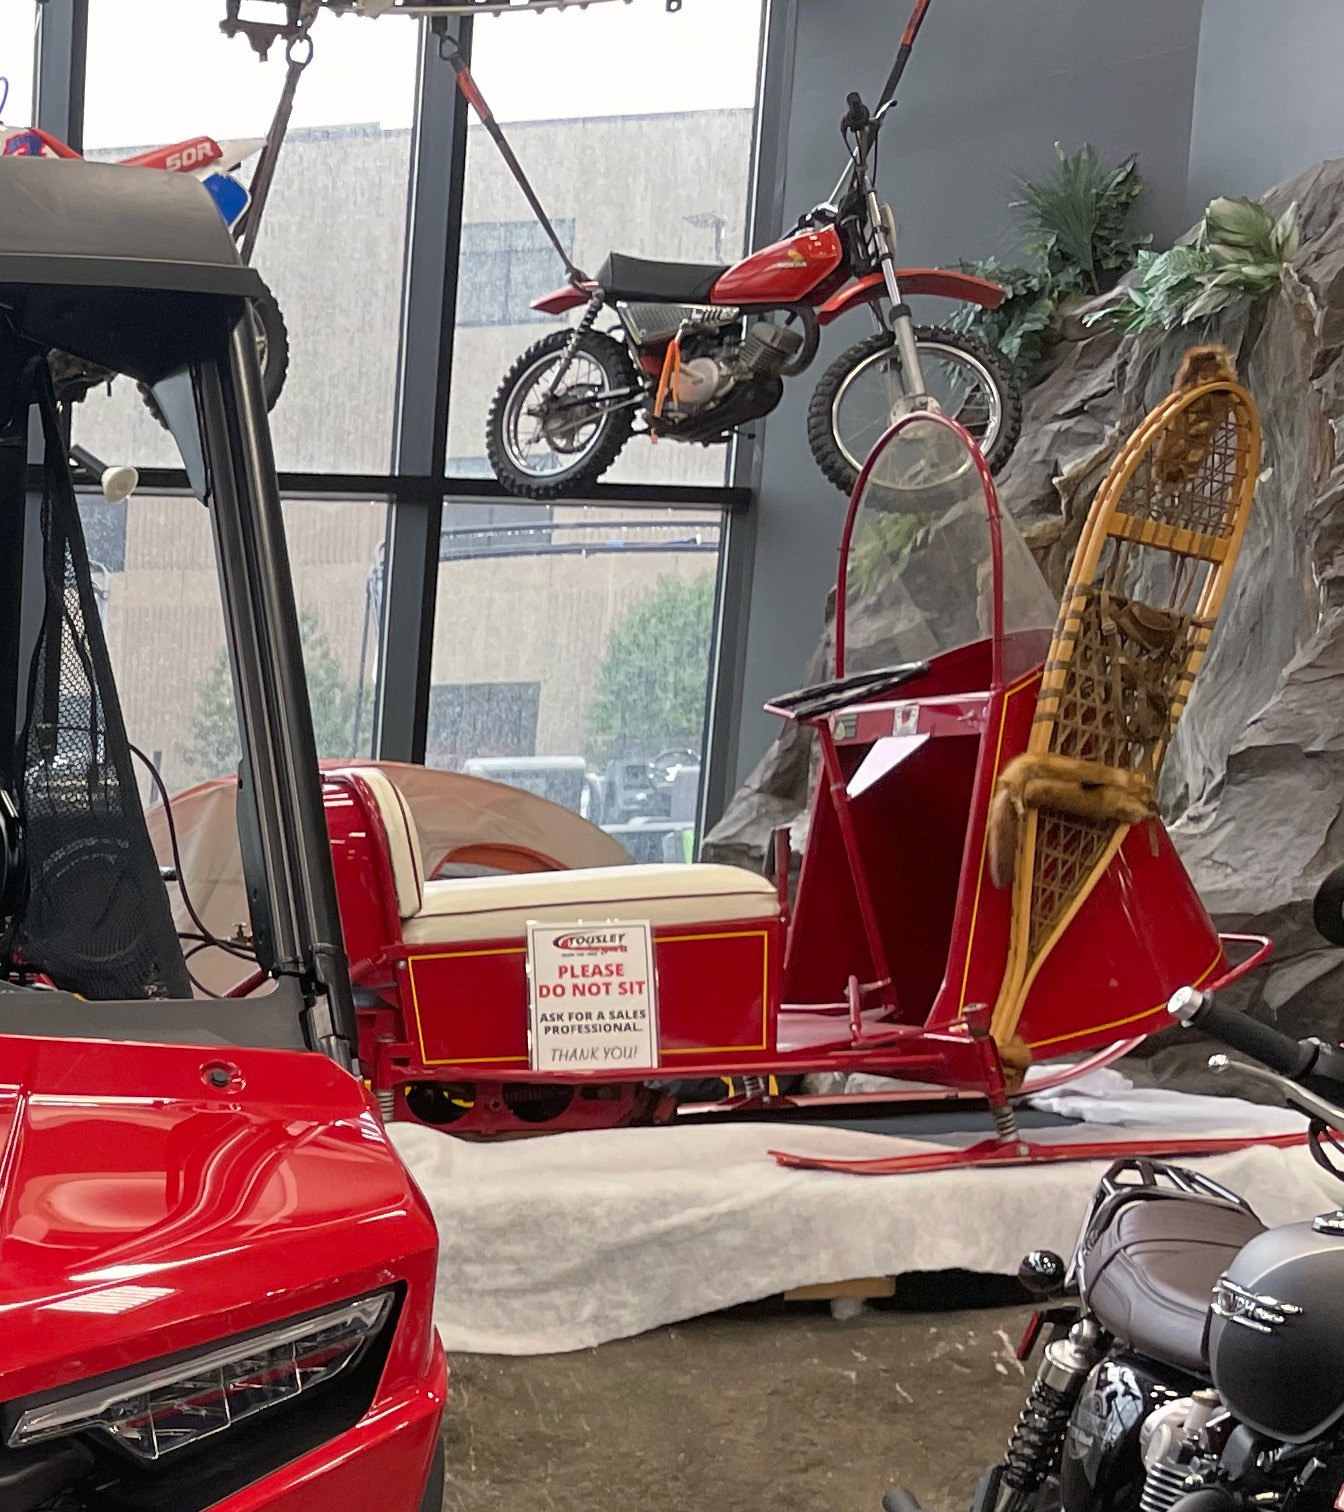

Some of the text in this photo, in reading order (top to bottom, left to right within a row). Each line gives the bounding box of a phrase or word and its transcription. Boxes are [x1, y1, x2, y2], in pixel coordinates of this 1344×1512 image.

[569, 933, 626, 946] TOUSLEY
[558, 962, 625, 979] PLEASE
[538, 980, 646, 999] DO NOT SIT
[539, 1008, 647, 1024] ASK FOR A SALES
[543, 1022, 644, 1036] PROFESSIONAL.
[551, 1045, 639, 1063] THANK YOU!
